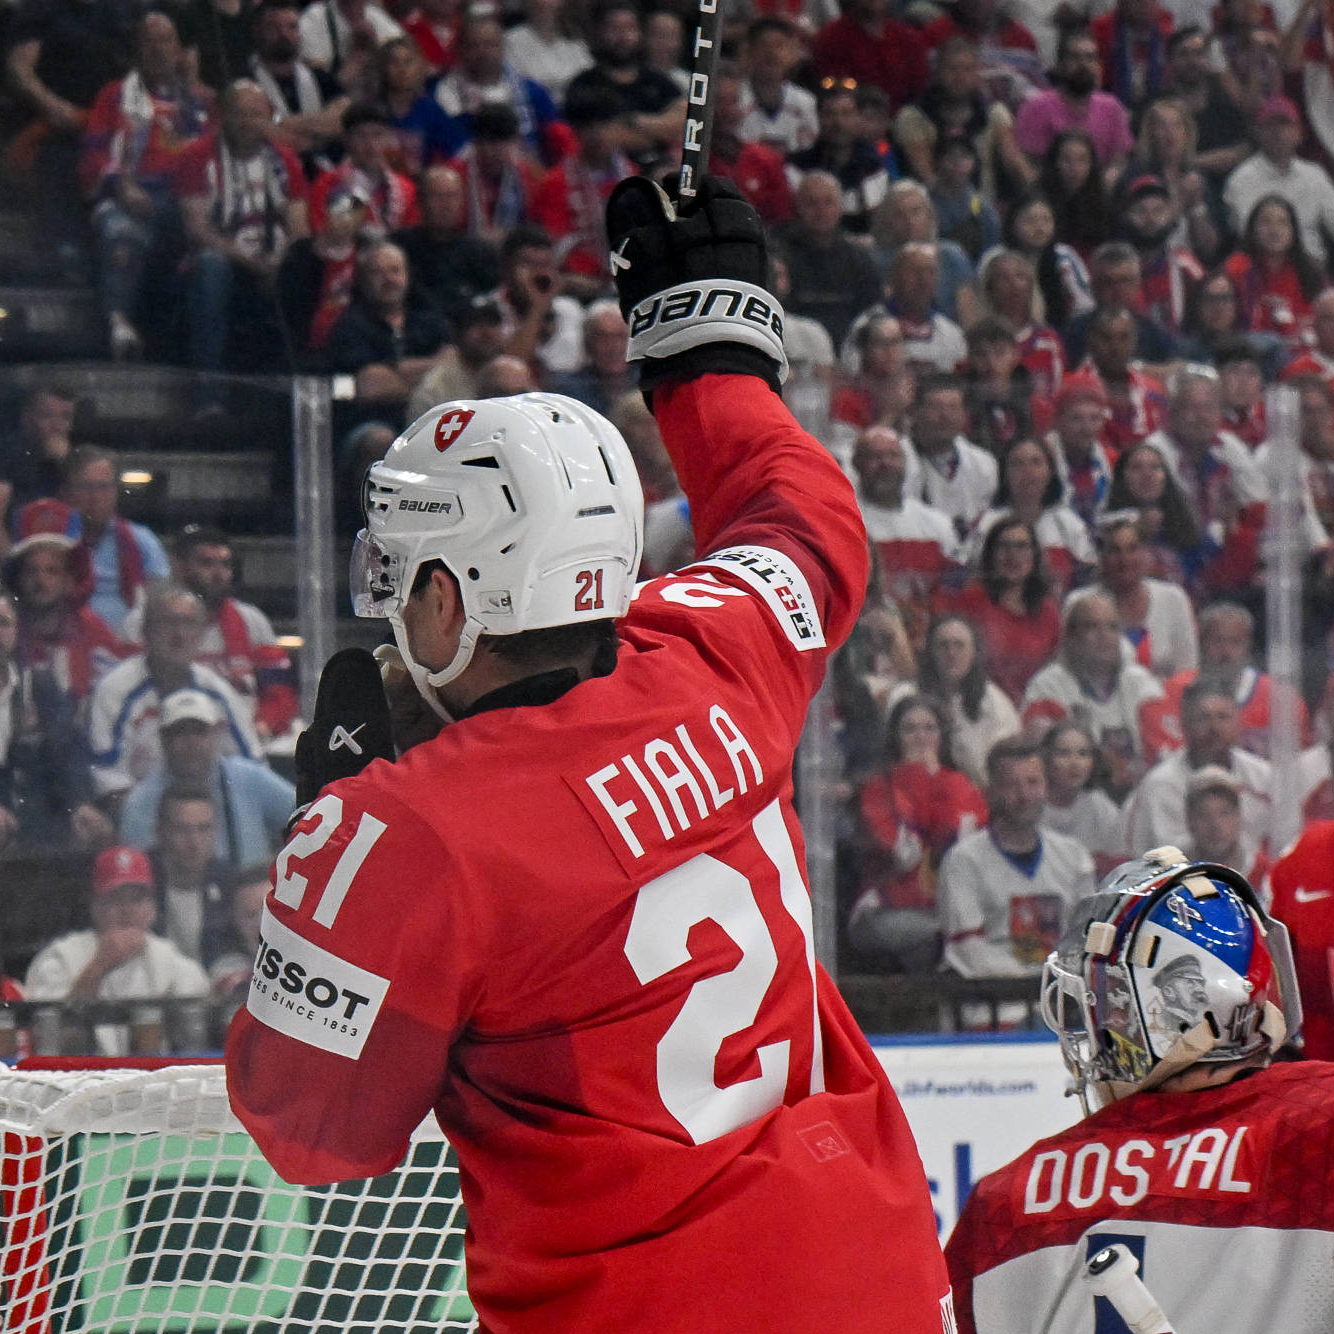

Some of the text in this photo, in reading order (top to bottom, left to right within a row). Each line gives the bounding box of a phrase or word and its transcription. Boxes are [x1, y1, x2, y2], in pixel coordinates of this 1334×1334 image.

[399, 499, 452, 514] BAUER
[575, 568, 605, 612] 21
[586, 704, 763, 858] FIALA
[274, 794, 388, 930] 21
[271, 992, 314, 1021] SINCE
[323, 1017, 358, 1038] 1853
[1024, 1126, 1253, 1215] DOSTAL
